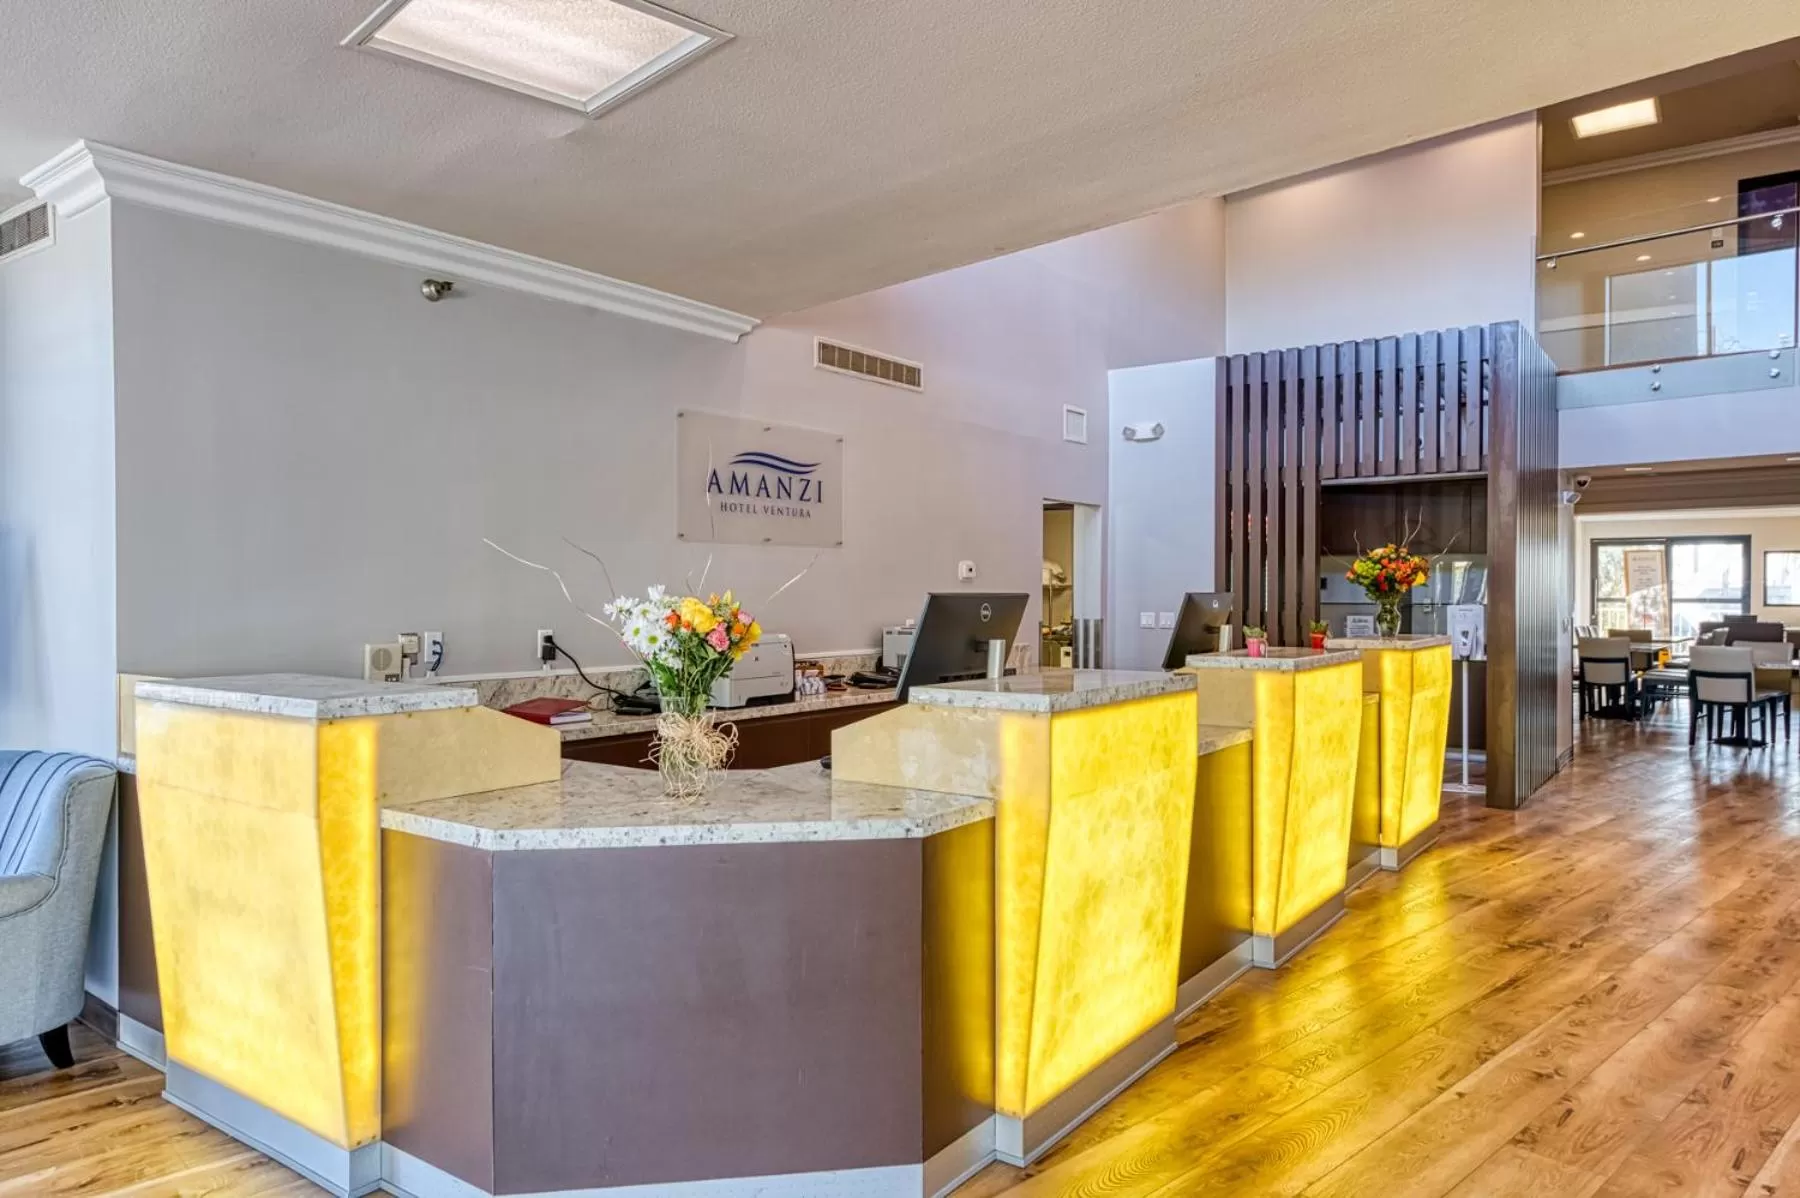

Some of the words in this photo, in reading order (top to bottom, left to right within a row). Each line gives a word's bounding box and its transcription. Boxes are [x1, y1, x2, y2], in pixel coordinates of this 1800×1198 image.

[707, 468, 822, 503] AMANZI
[720, 501, 757, 514] HOTEL
[763, 505, 811, 518] VENTURA
